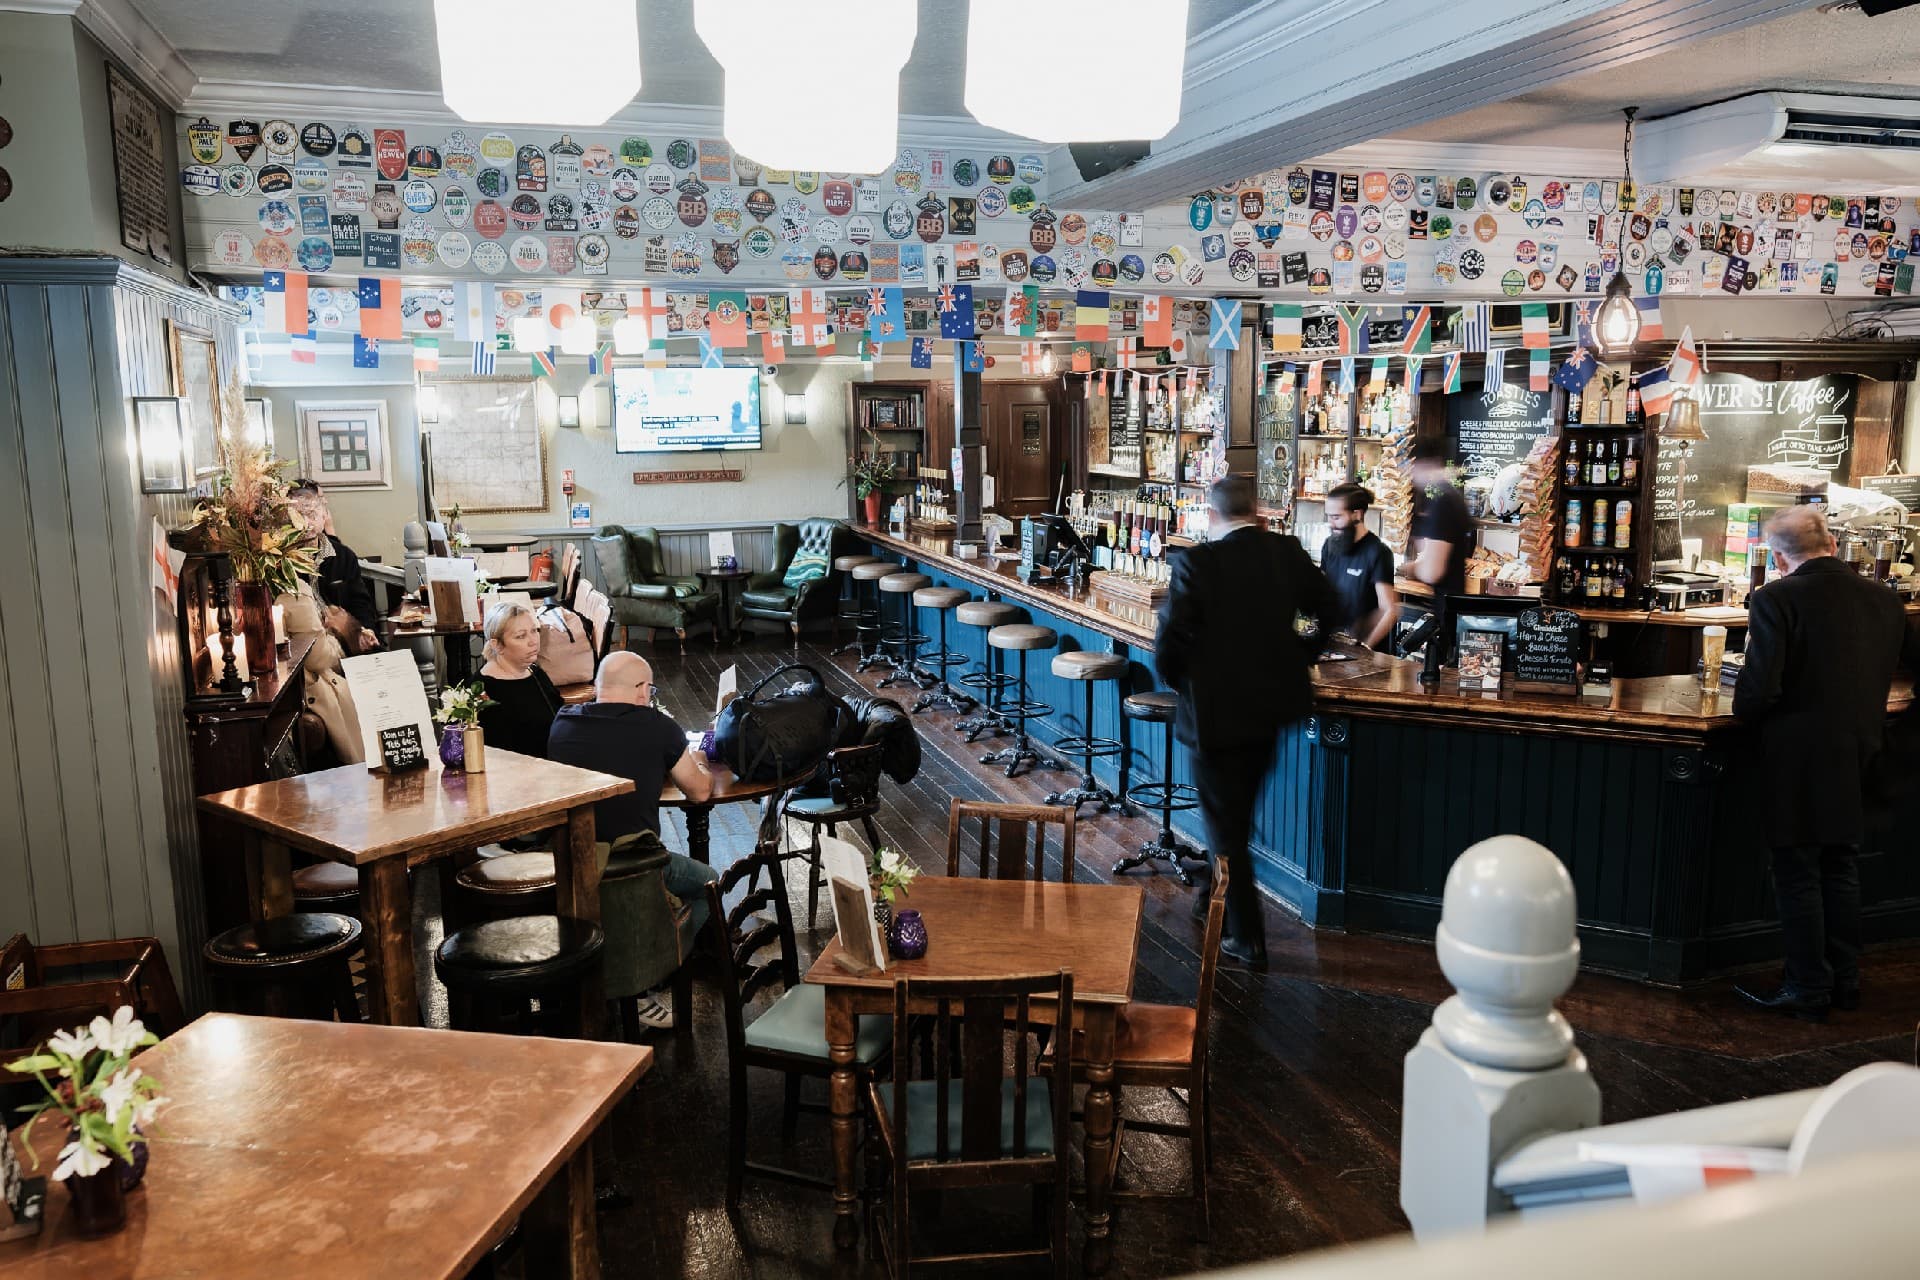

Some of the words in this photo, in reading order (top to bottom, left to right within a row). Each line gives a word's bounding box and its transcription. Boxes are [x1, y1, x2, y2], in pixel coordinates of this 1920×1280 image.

[192, 132, 219, 140] HARVEST
[378, 150, 405, 160] HEAVEN
[680, 202, 706, 216] BB
[918, 218, 944, 232] BB
[1032, 230, 1056, 243] BB
[1480, 382, 1540, 408] TOASTIES
[1778, 380, 1836, 414] Coffee
[1520, 630, 1536, 640] Ham
[1545, 632, 1568, 642] Cheese
[1550, 655, 1572, 664] Tomato
